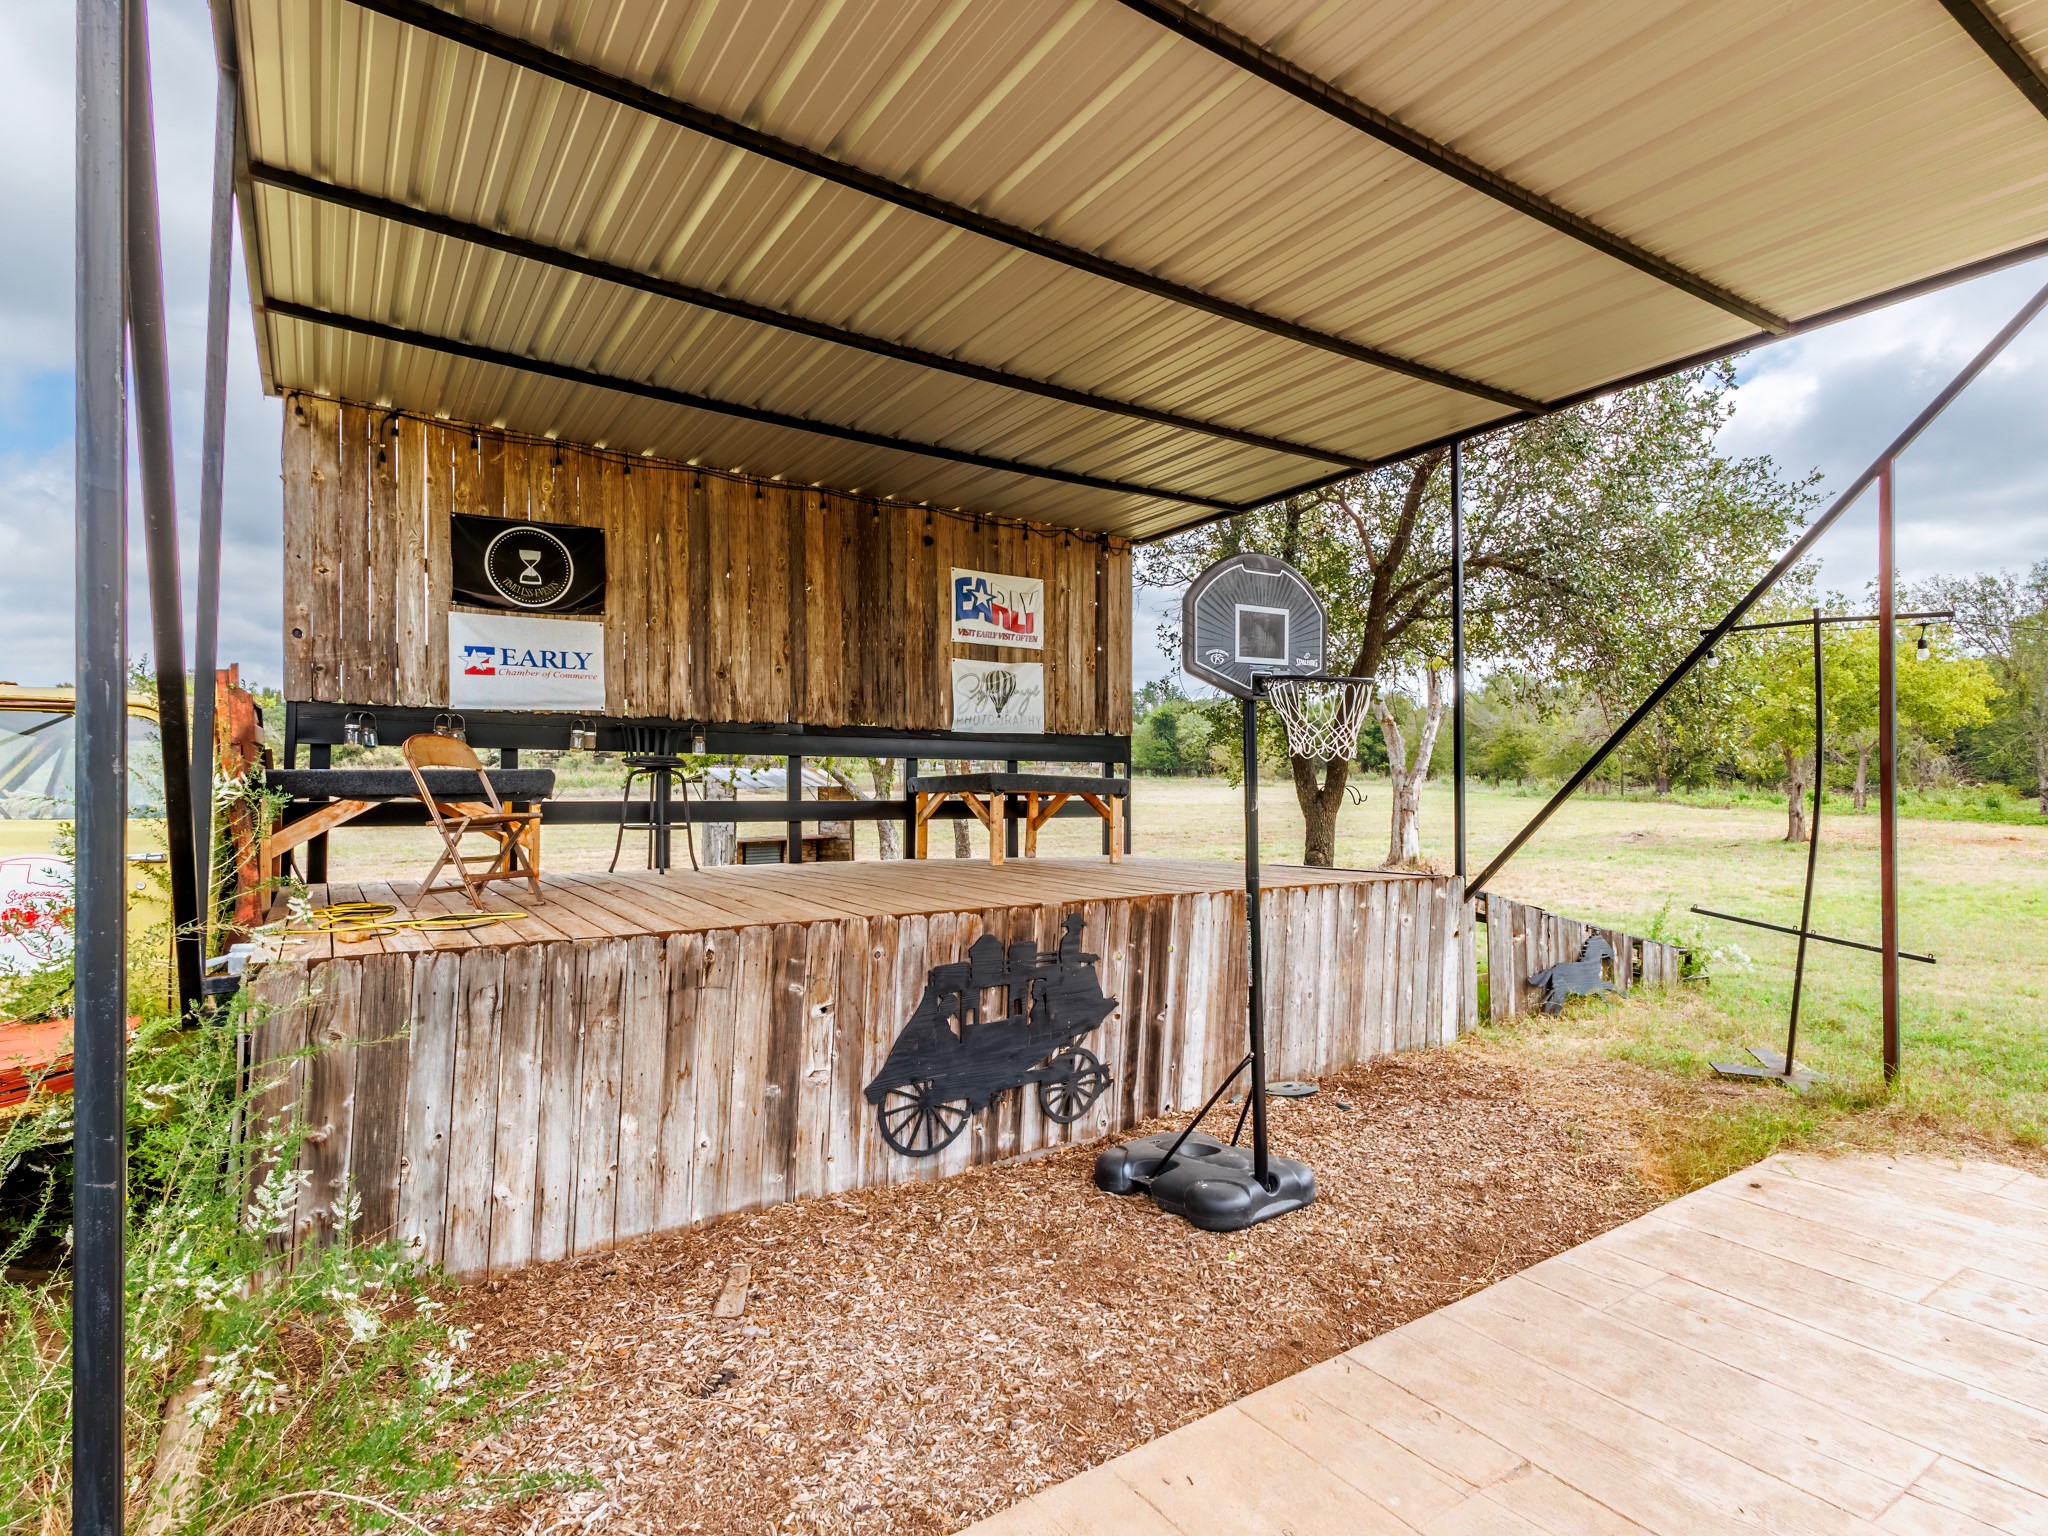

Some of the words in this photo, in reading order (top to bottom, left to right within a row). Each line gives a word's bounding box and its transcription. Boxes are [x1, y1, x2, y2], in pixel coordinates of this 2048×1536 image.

[955, 577, 1040, 634] EARLY
[958, 628, 976, 637] VISIT
[976, 630, 998, 639] EARLY
[998, 632, 1016, 641] VISIT
[1015, 634, 1039, 643] OFTEN
[499, 647, 594, 671] EARLY
[498, 668, 540, 677] Chamber
[542, 671, 553, 679] of
[553, 671, 598, 681] Commerce
